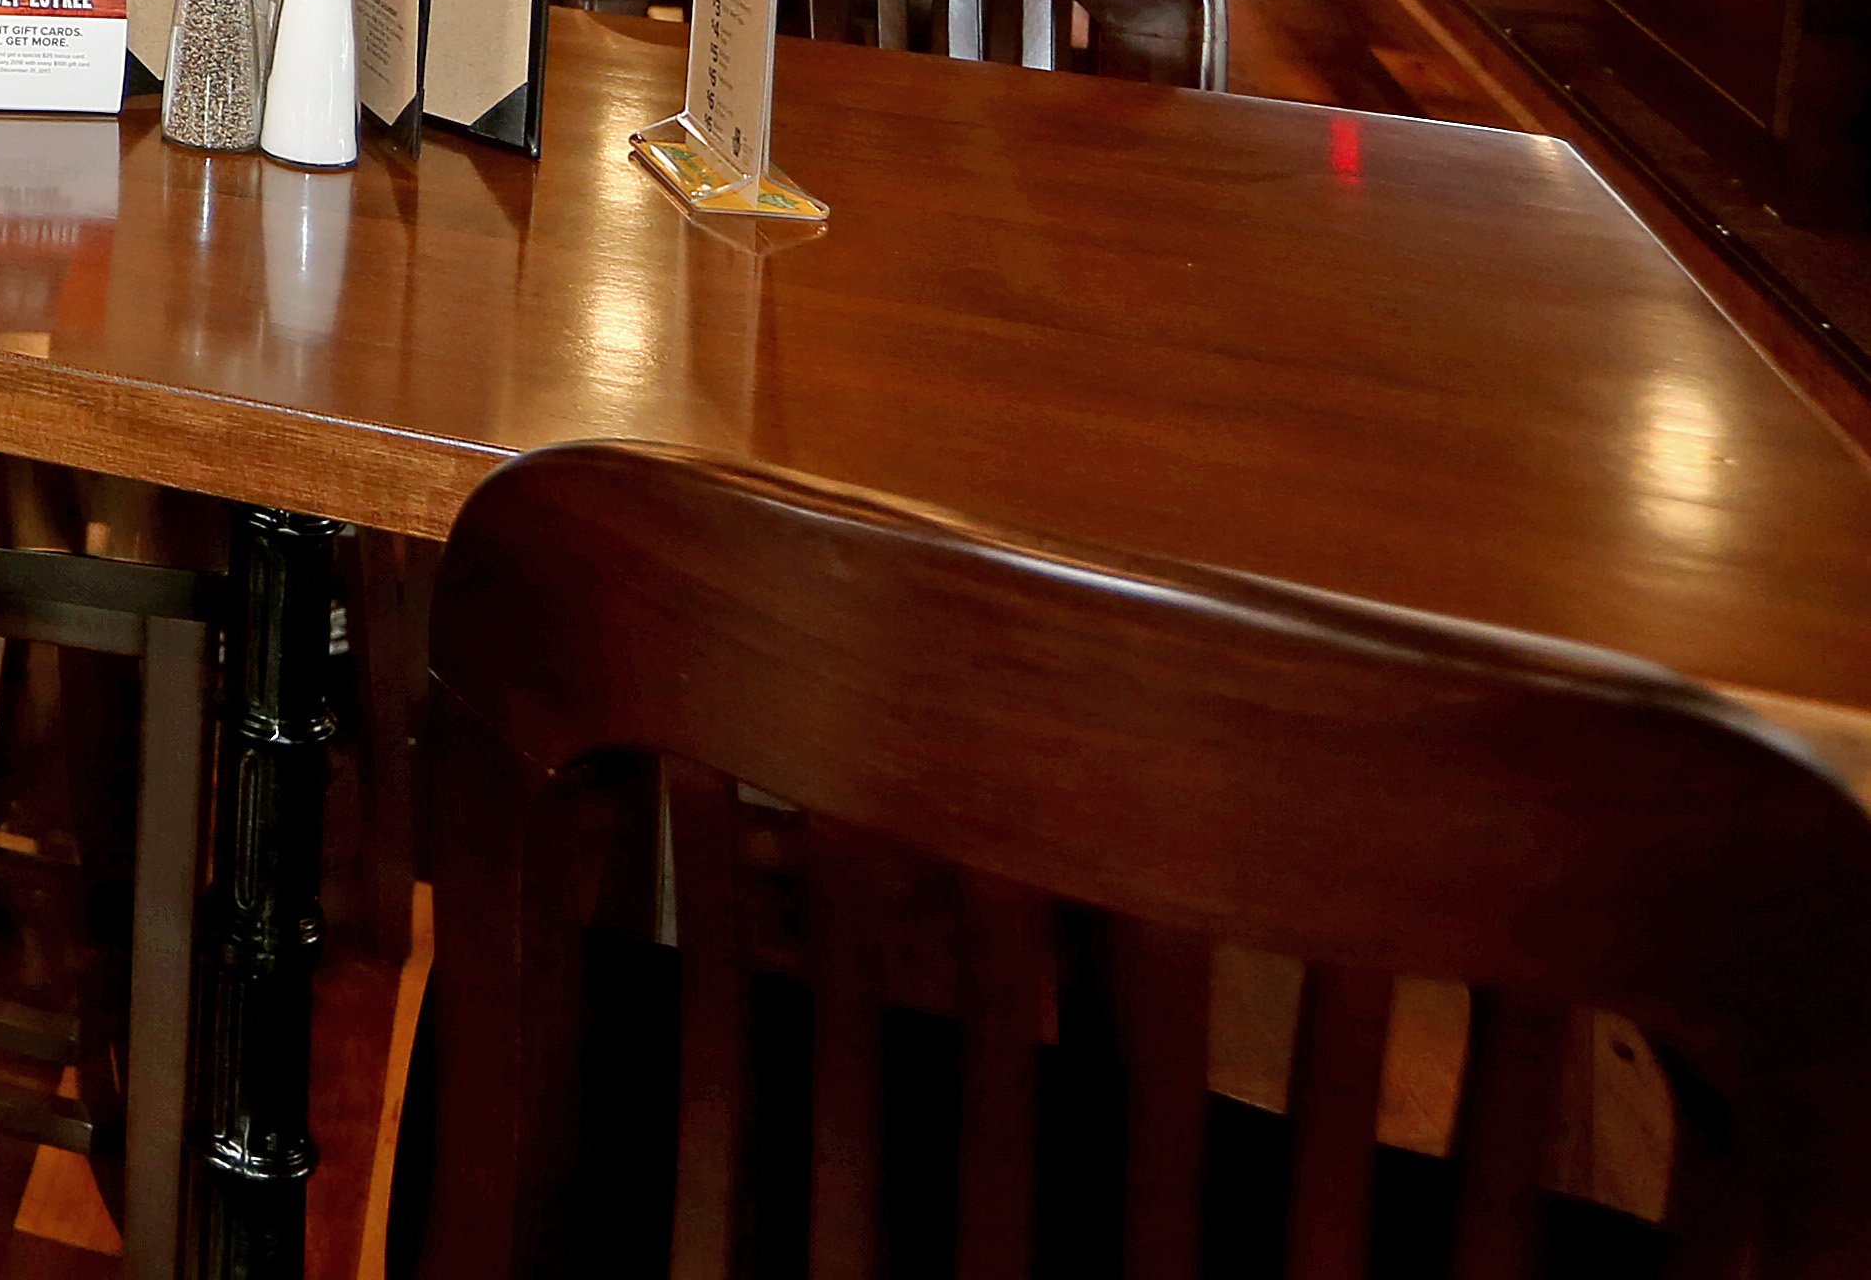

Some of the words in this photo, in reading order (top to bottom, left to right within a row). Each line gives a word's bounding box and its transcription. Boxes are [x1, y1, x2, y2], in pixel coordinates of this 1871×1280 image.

[12, 25, 38, 36] GIFT
[40, 26, 83, 37] CARDS.
[5, 36, 28, 46] GET
[32, 37, 69, 47] MORE.
